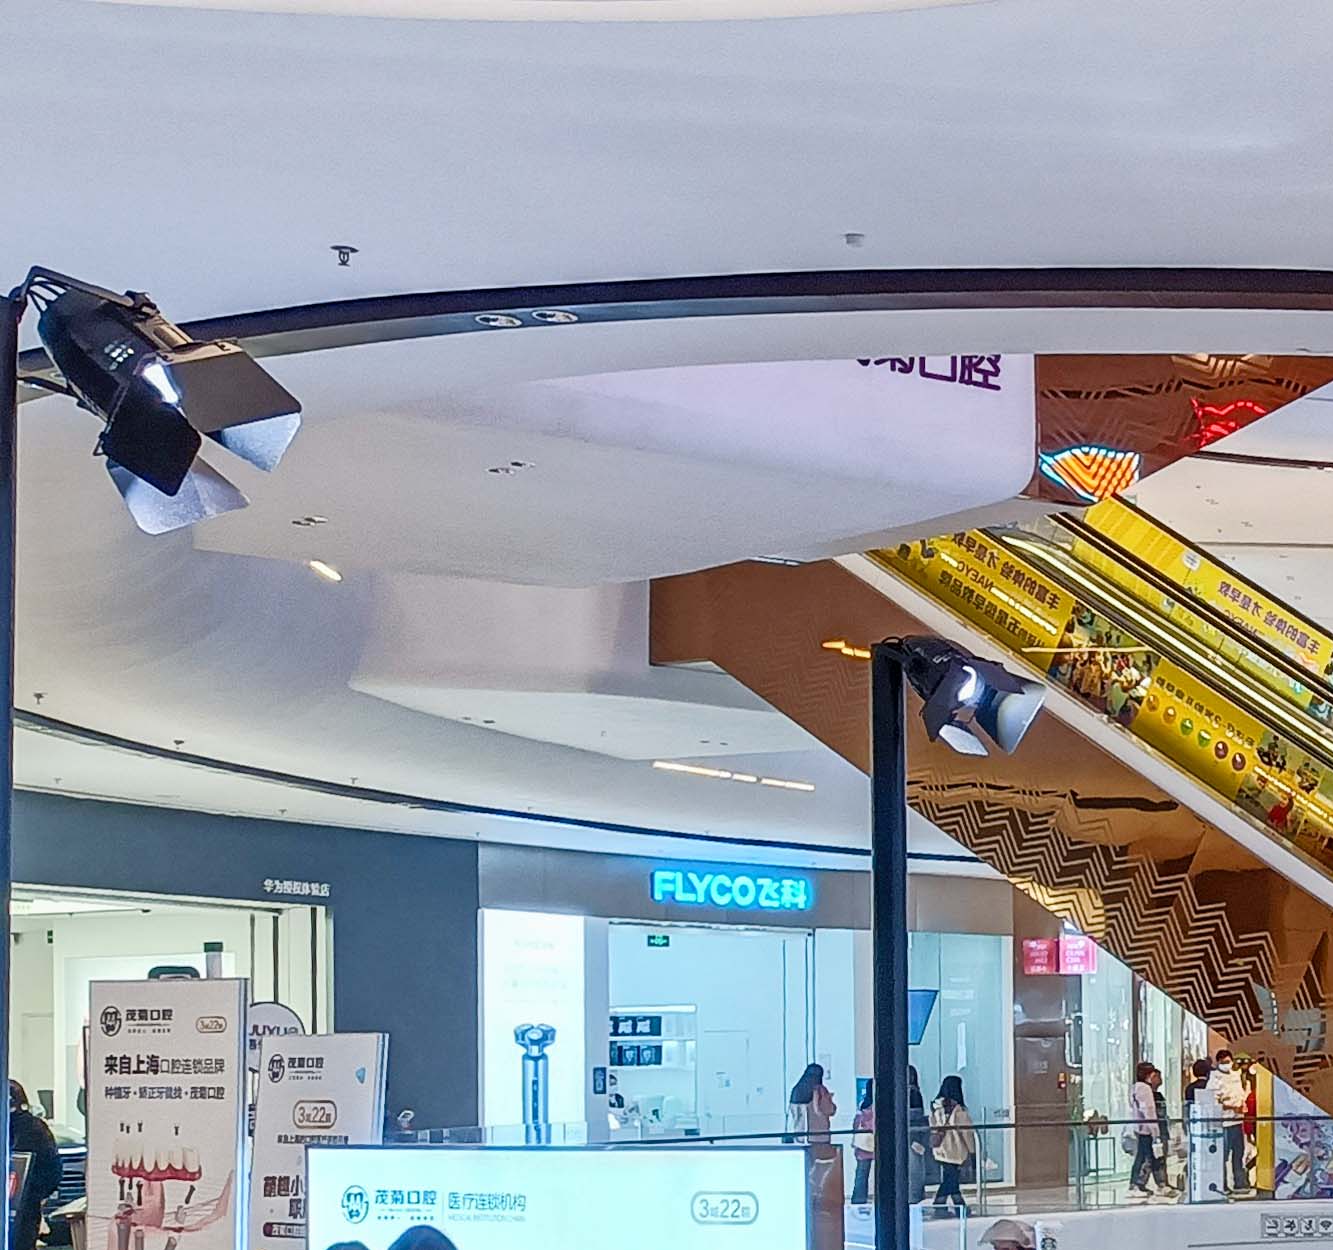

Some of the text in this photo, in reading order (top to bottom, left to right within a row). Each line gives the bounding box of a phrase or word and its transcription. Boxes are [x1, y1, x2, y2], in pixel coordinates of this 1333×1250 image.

[856, 354, 1001, 391] 口腔
[374, 1190, 526, 1212] 茂菊口腔 医疗连锁机构
